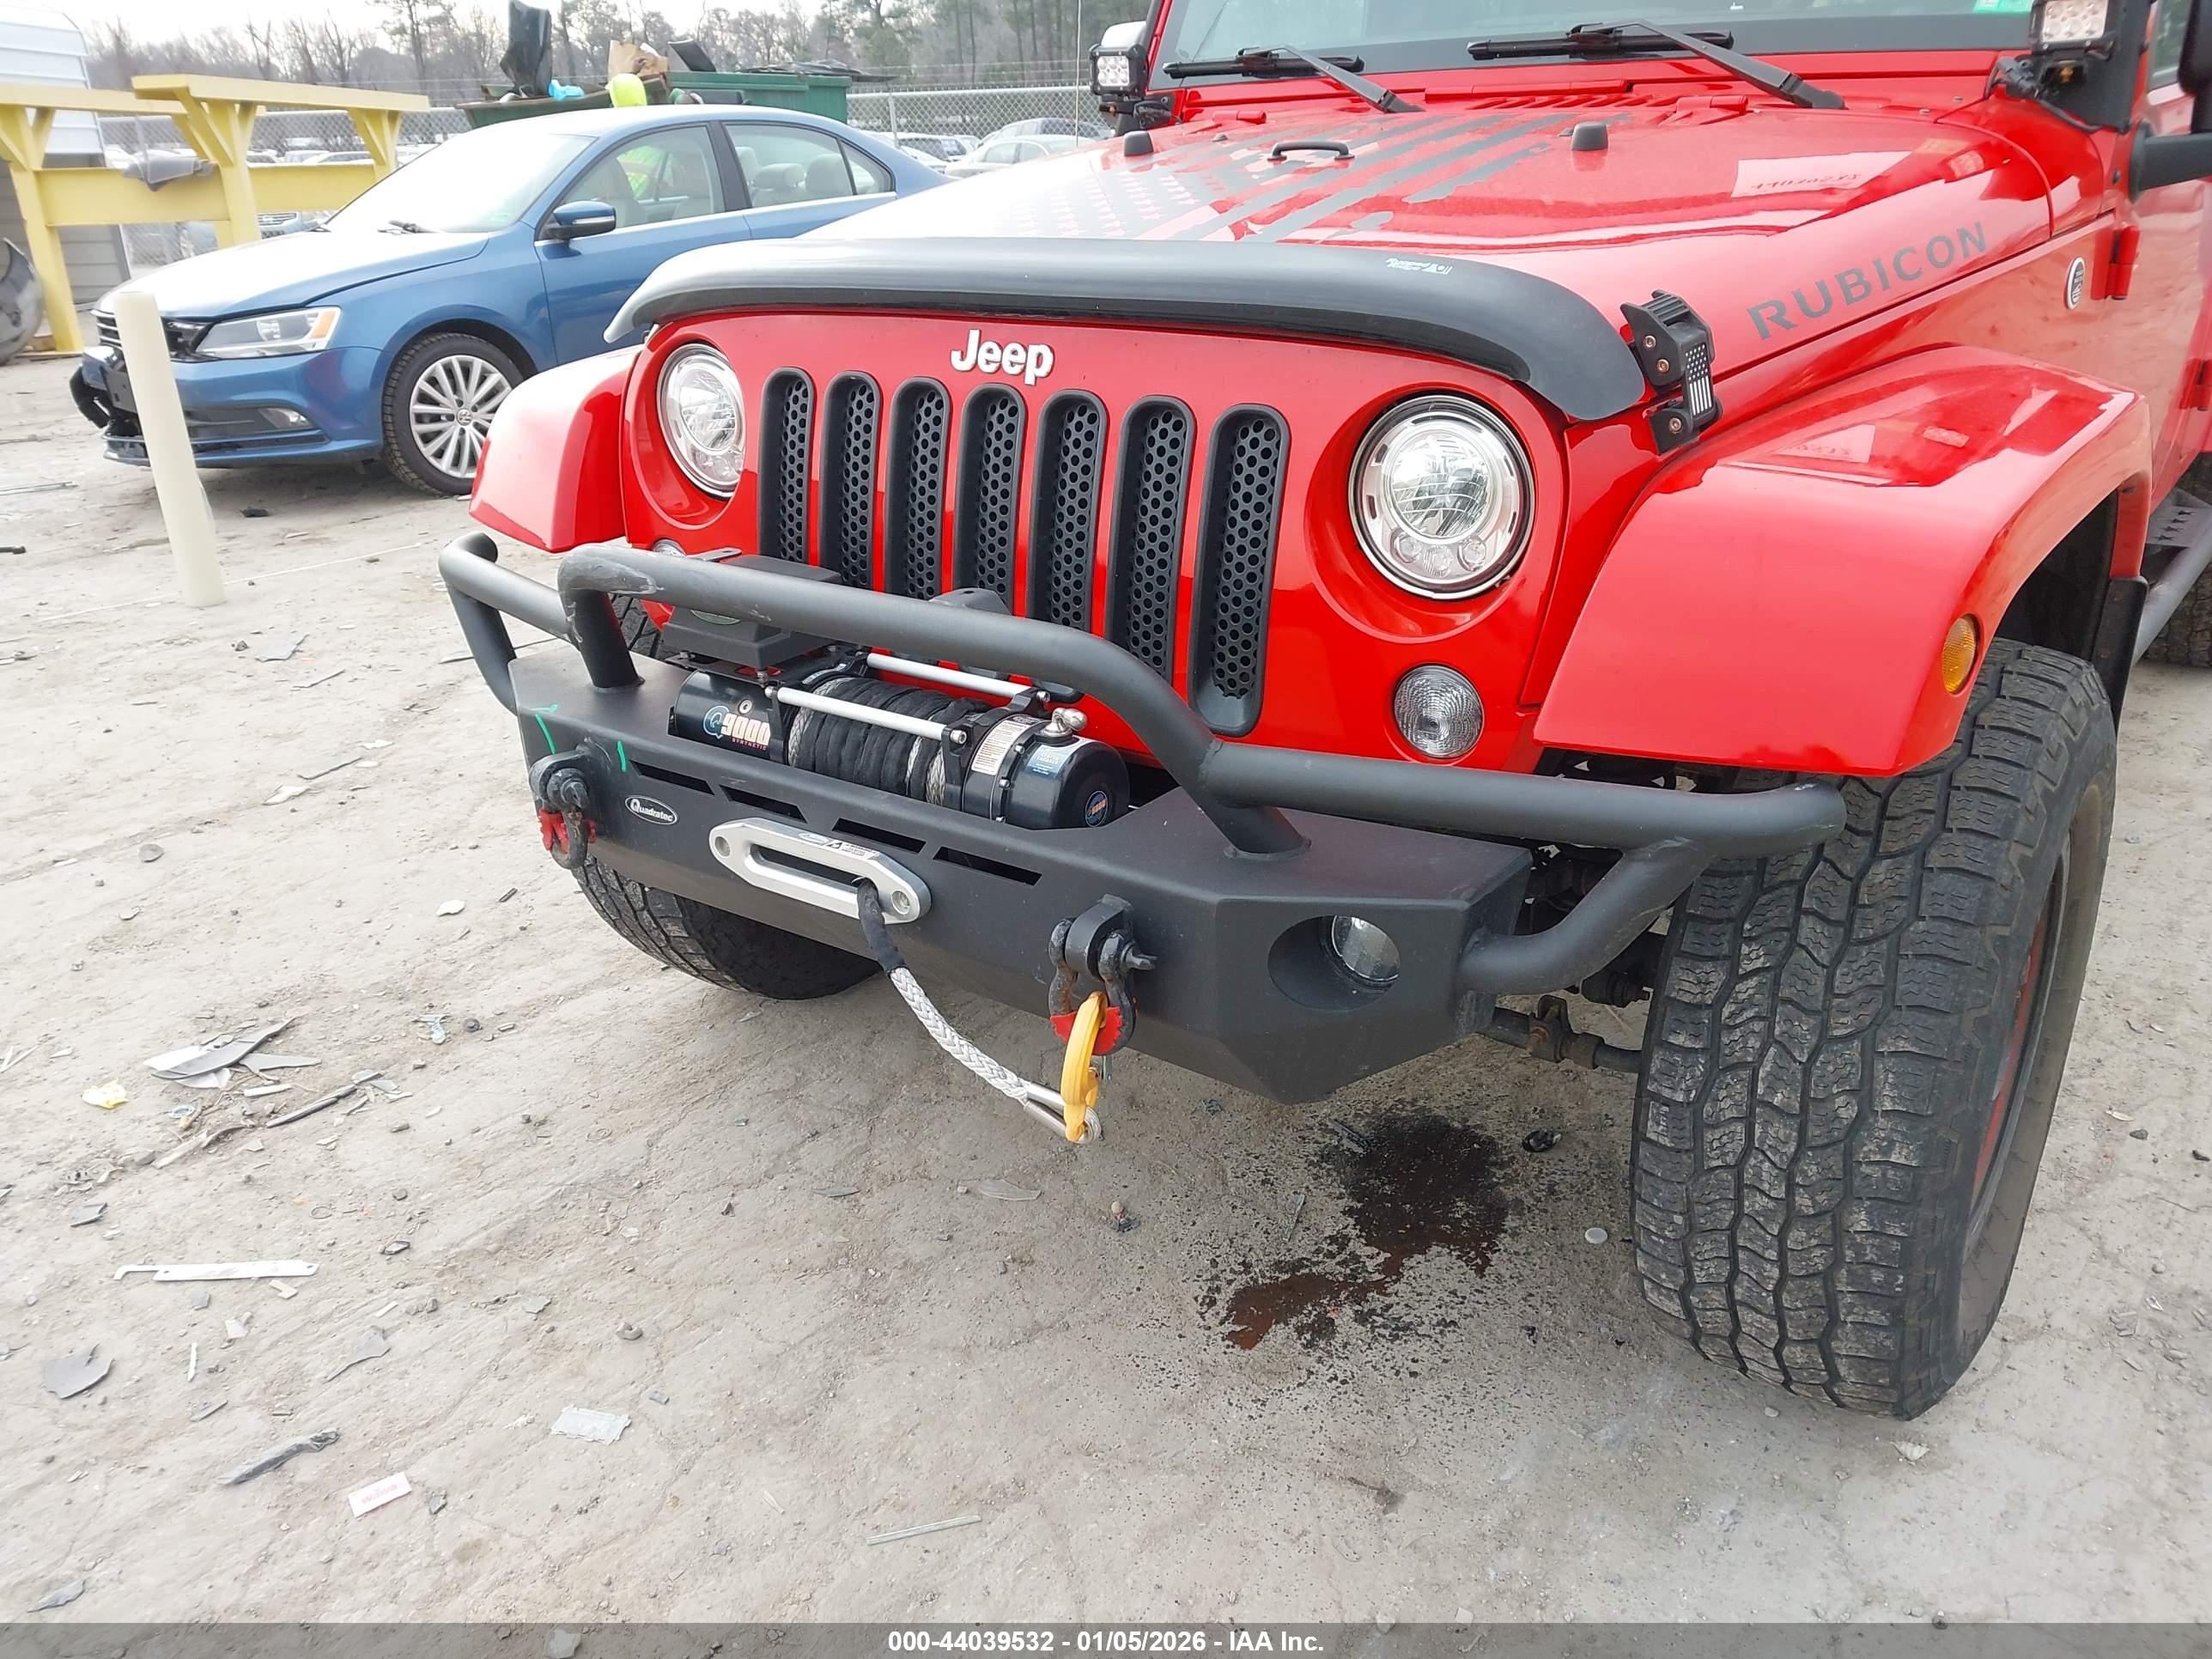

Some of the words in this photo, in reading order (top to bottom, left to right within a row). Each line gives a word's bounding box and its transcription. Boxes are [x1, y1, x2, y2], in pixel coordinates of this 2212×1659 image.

[1746, 221, 1987, 340] RUBICON
[951, 328, 1054, 386] Jeep
[732, 738, 768, 750] SYNTHETIC
[629, 798, 674, 822] Quadratec
